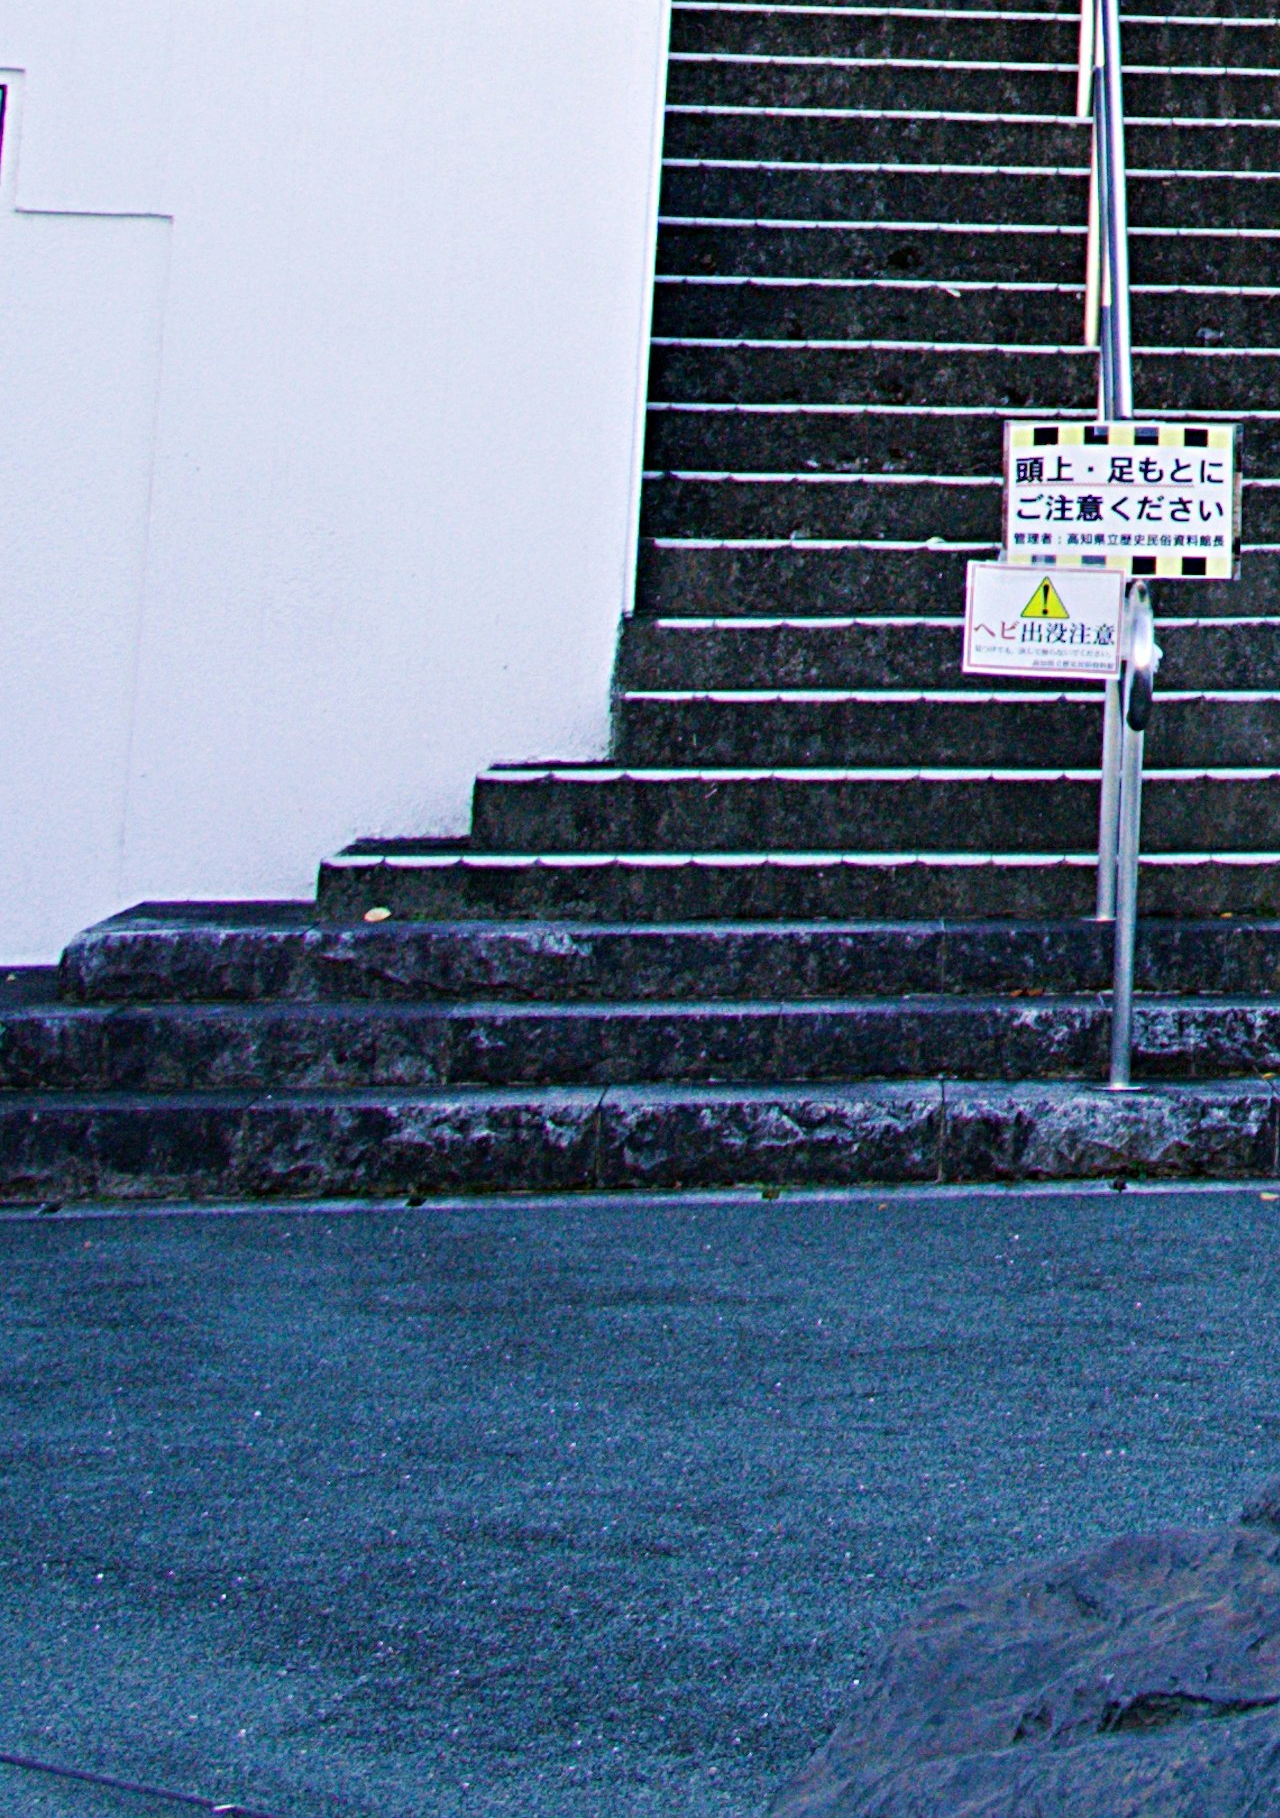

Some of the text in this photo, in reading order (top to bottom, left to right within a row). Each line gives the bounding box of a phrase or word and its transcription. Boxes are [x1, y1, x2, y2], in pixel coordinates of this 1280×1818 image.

[1015, 456, 1224, 483] 頭上・足もとに
[1016, 494, 1224, 522] ご注意ください
[973, 621, 1116, 646] ヘビ出没注意
